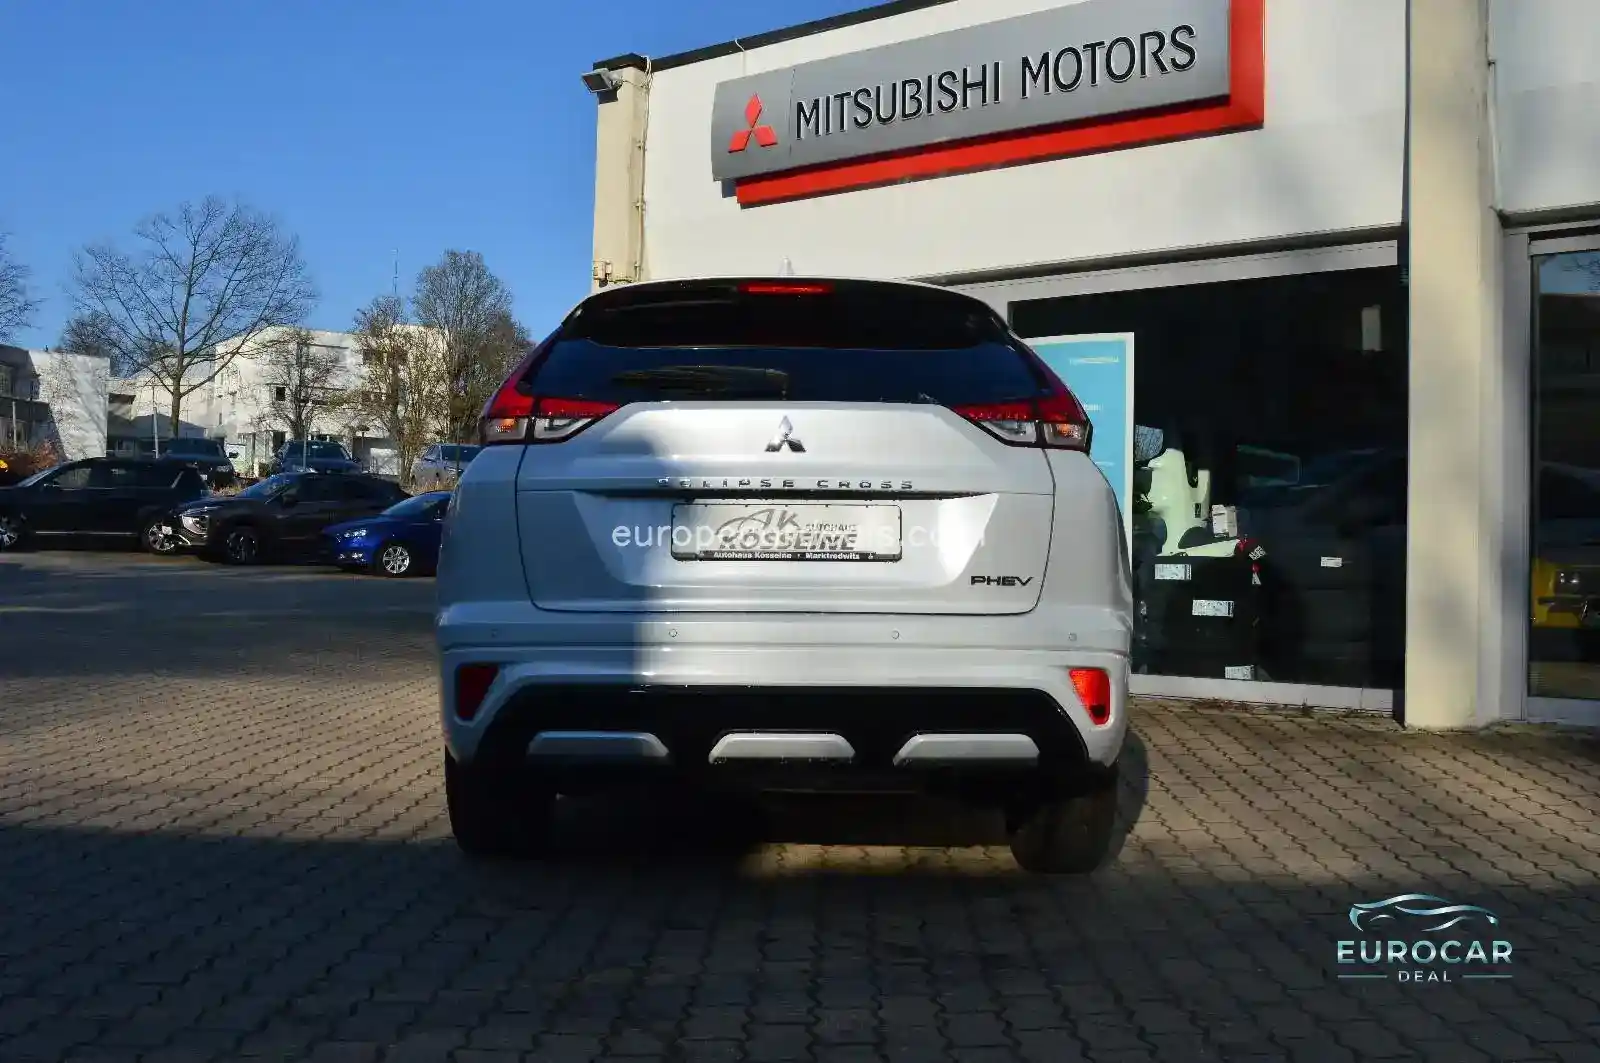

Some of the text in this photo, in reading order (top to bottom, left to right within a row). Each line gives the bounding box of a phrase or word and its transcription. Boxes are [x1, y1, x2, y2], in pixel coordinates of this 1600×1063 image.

[796, 23, 1197, 141] MITSUBISHI MOTORS
[658, 477, 913, 490] ECLIPSE CROSS
[713, 551, 752, 560] Autohaus
[970, 575, 1034, 586] PHEV
